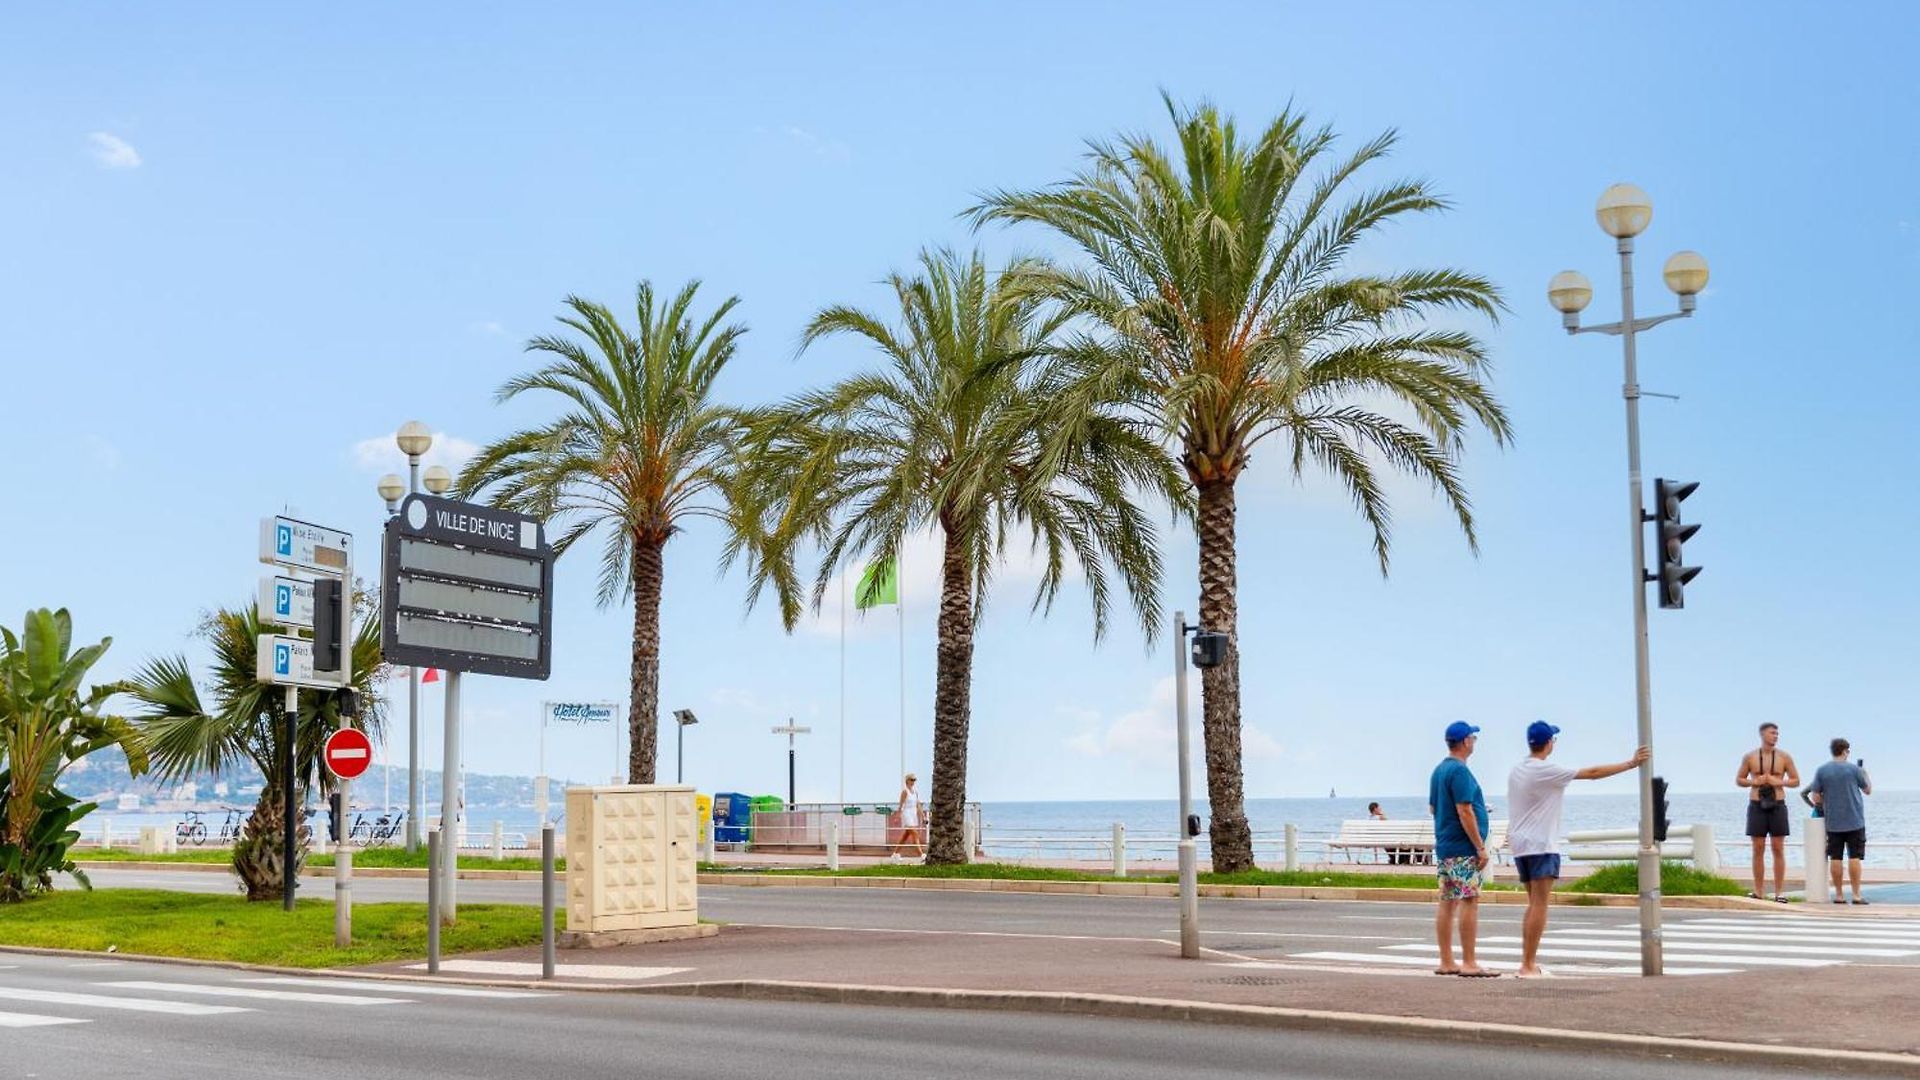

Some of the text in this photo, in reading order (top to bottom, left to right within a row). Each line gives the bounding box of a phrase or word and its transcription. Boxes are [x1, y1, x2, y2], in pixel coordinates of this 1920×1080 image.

[436, 509, 515, 541] VILLE DE NICE
